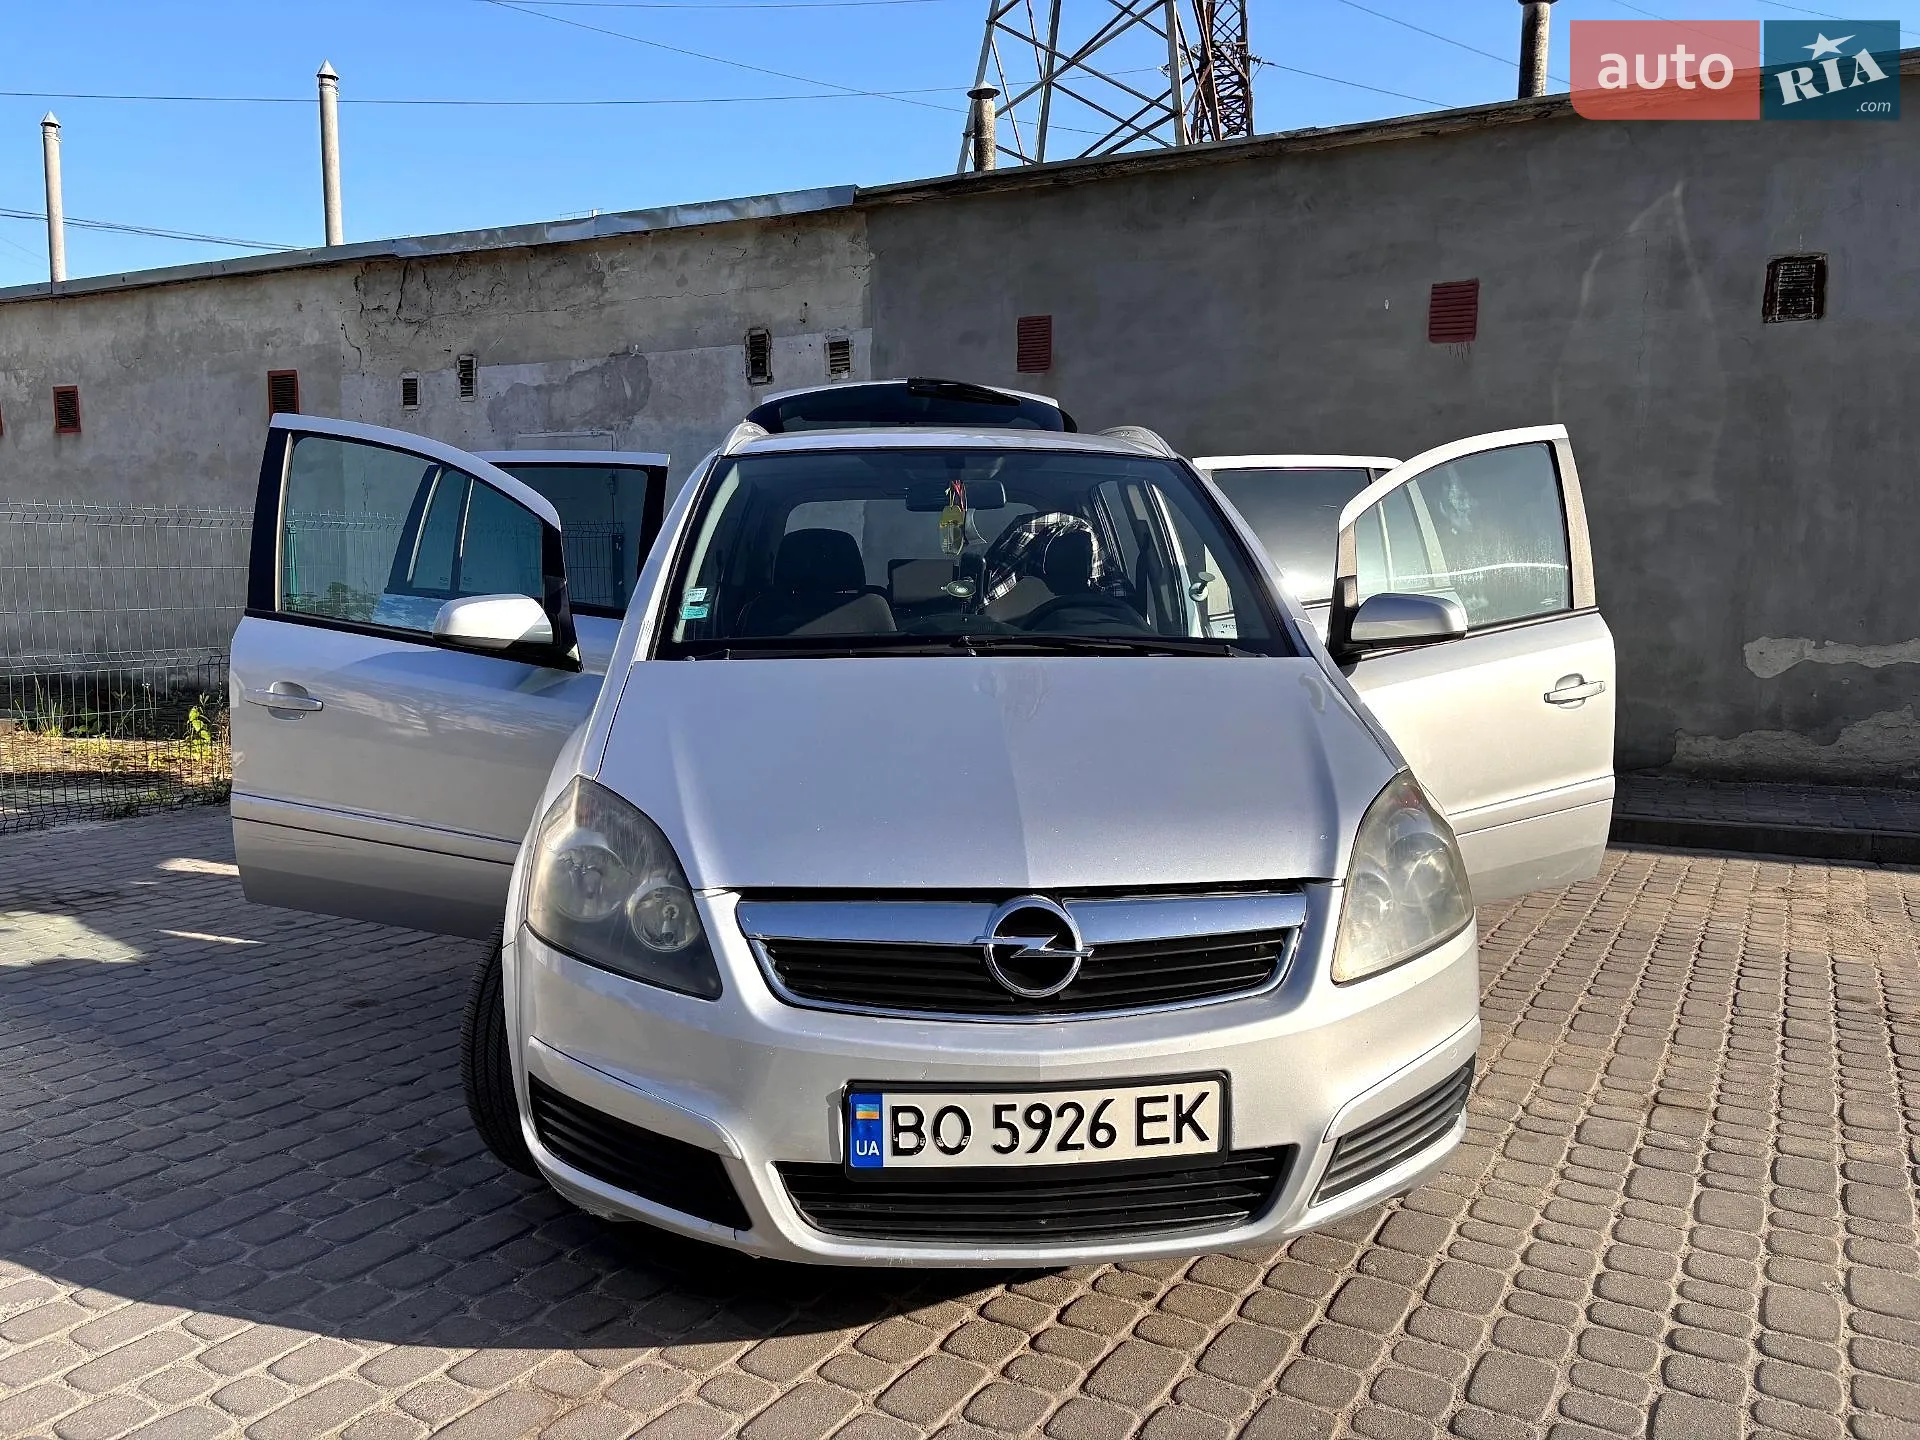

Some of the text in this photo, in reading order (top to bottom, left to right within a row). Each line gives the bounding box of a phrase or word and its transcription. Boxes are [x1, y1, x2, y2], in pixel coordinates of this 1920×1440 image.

[890, 1091, 1211, 1156] BO 5926 EK
[856, 1140, 880, 1156] UA
